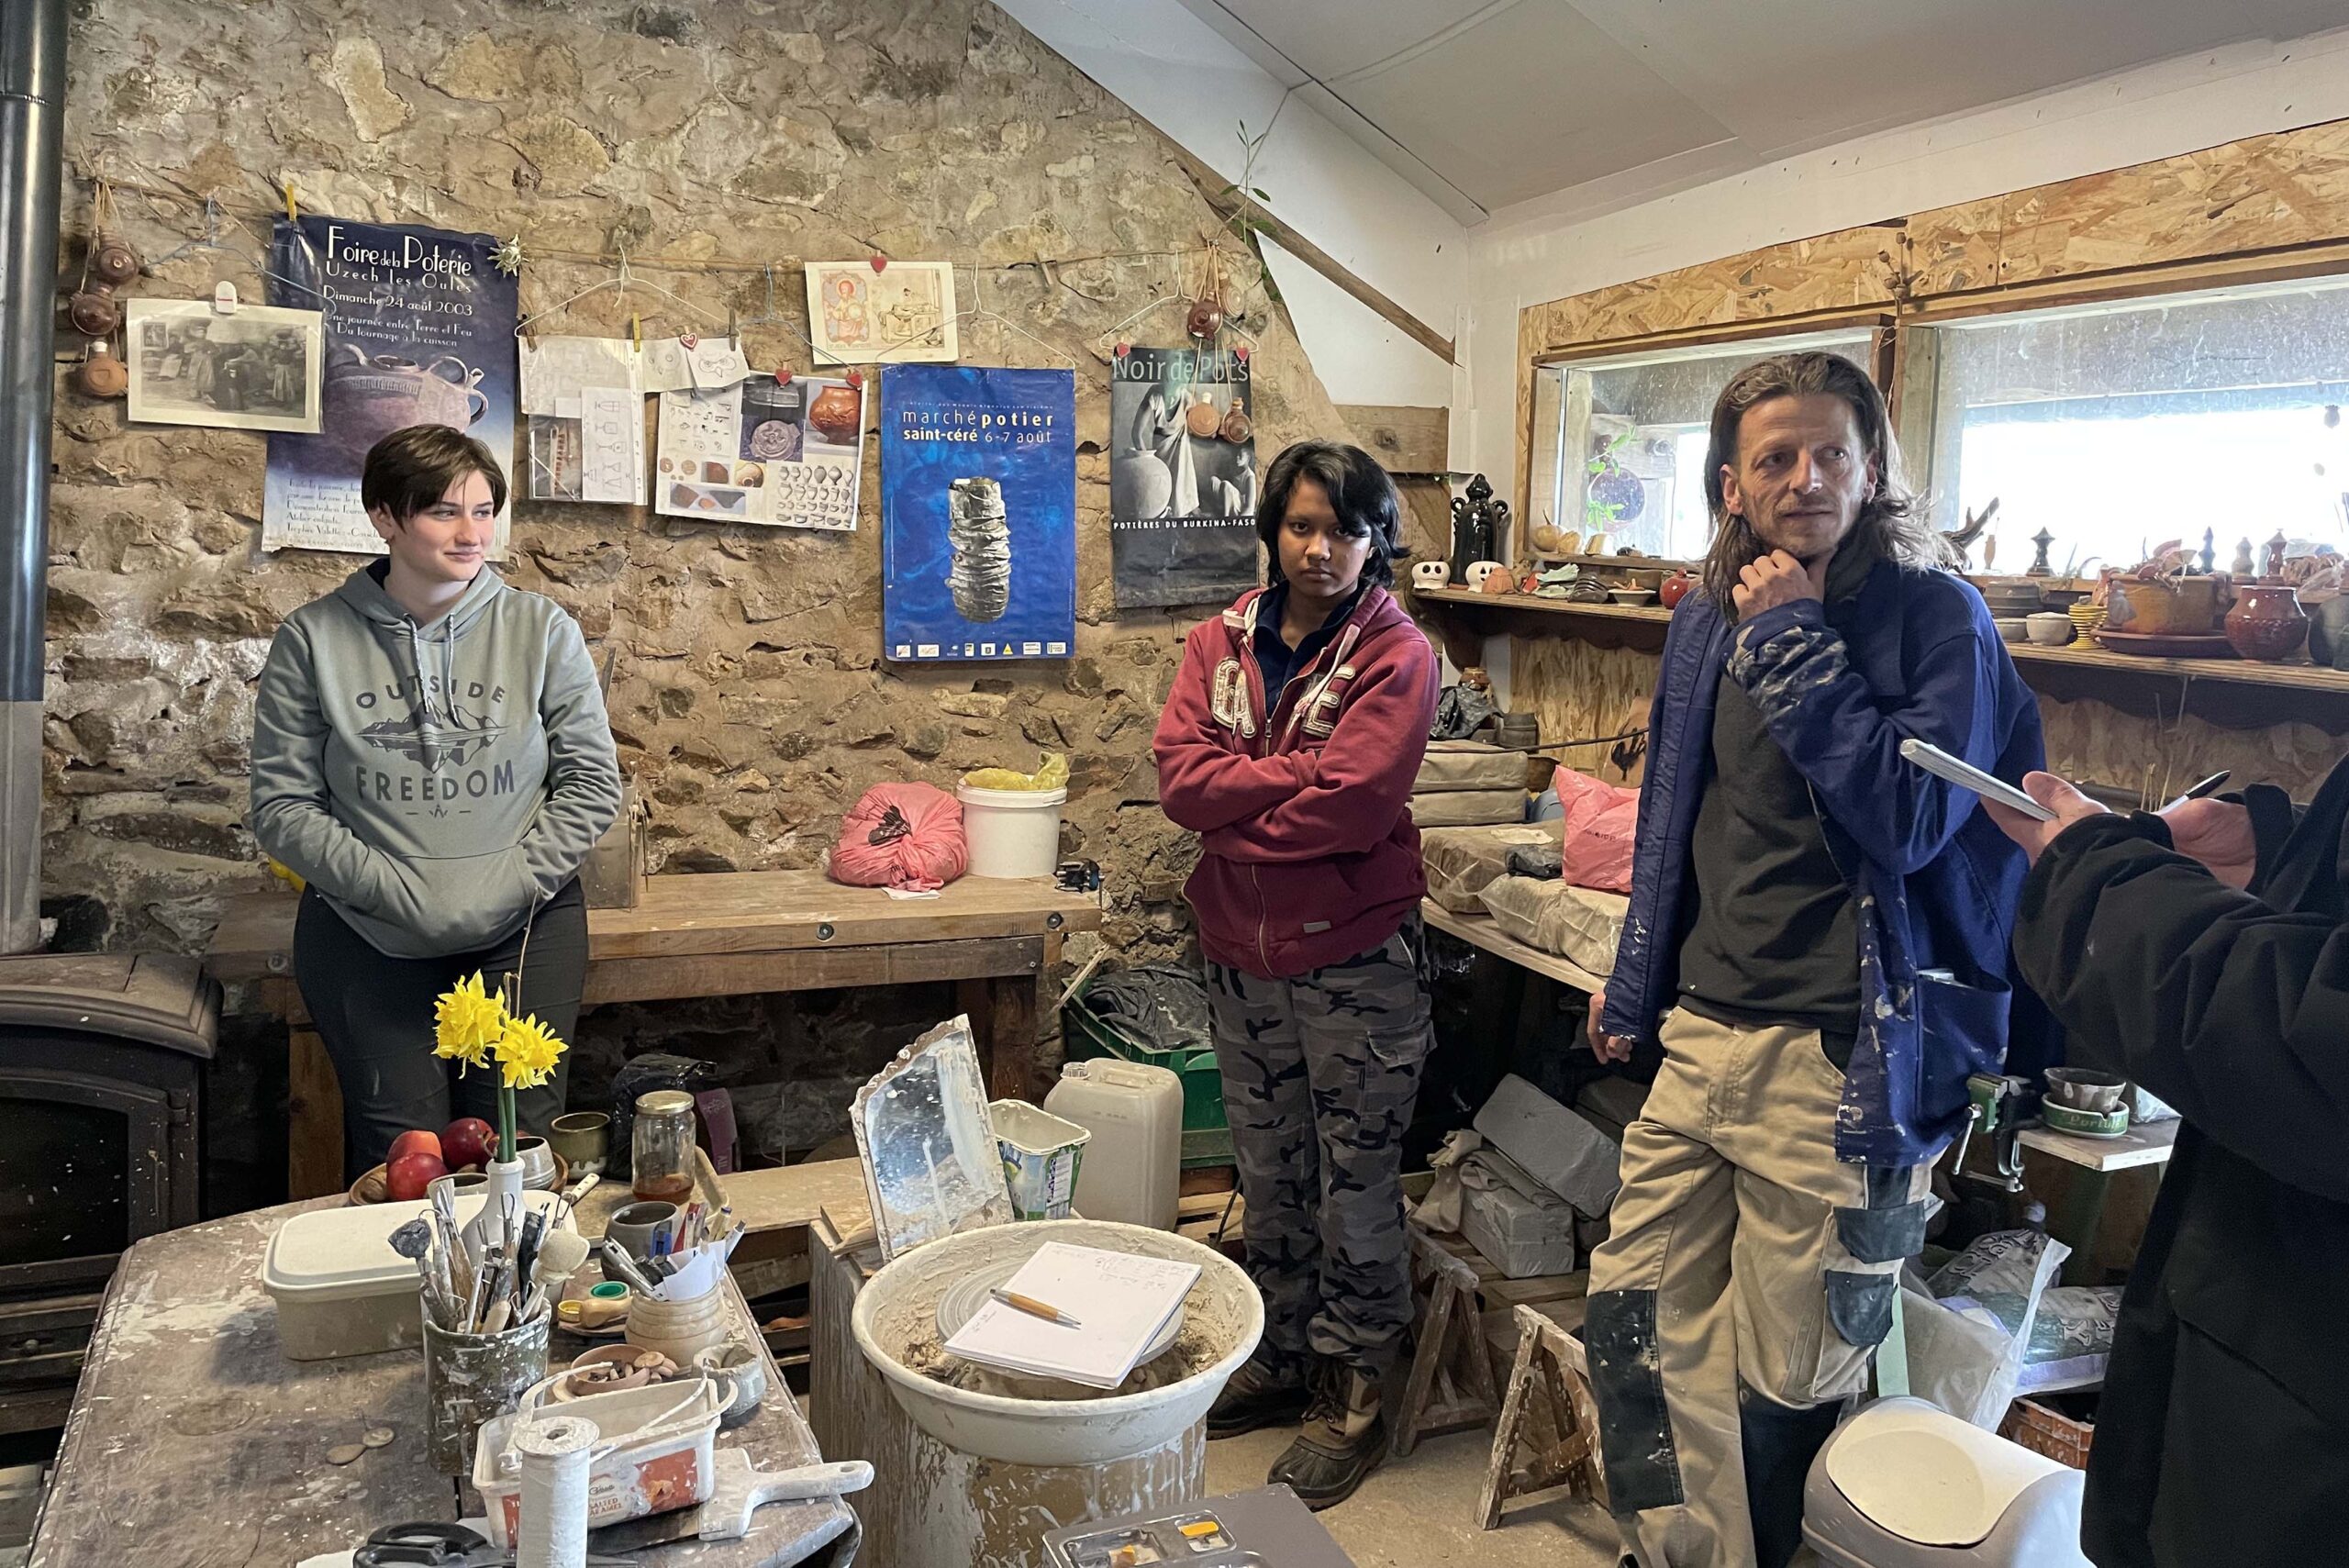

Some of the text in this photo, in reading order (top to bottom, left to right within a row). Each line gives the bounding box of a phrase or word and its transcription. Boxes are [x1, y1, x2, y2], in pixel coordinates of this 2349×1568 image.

[328, 225, 379, 265] Foire
[404, 235, 472, 277] Poterie
[326, 261, 472, 294] Uzech les Oules
[323, 284, 473, 316] Dimanche 24 août 2003
[337, 321, 353, 336] Du
[357, 325, 400, 343] tournage
[423, 337, 457, 348] cuisson
[386, 319, 410, 330] entre
[415, 318, 440, 333] Terre
[441, 324, 451, 335] et
[453, 323, 473, 338] Feu
[1112, 352, 1249, 382] Noir de Pots
[903, 409, 1053, 428] marché potier
[903, 427, 1051, 443] saint-céré 6-7 août
[1113, 518, 1255, 530] POTIÈRES DU BURKINA-FASO
[356, 674, 507, 709] OUTSIDE
[355, 759, 515, 802] FREEDOM
[589, 1502, 621, 1516] ARAMEL
